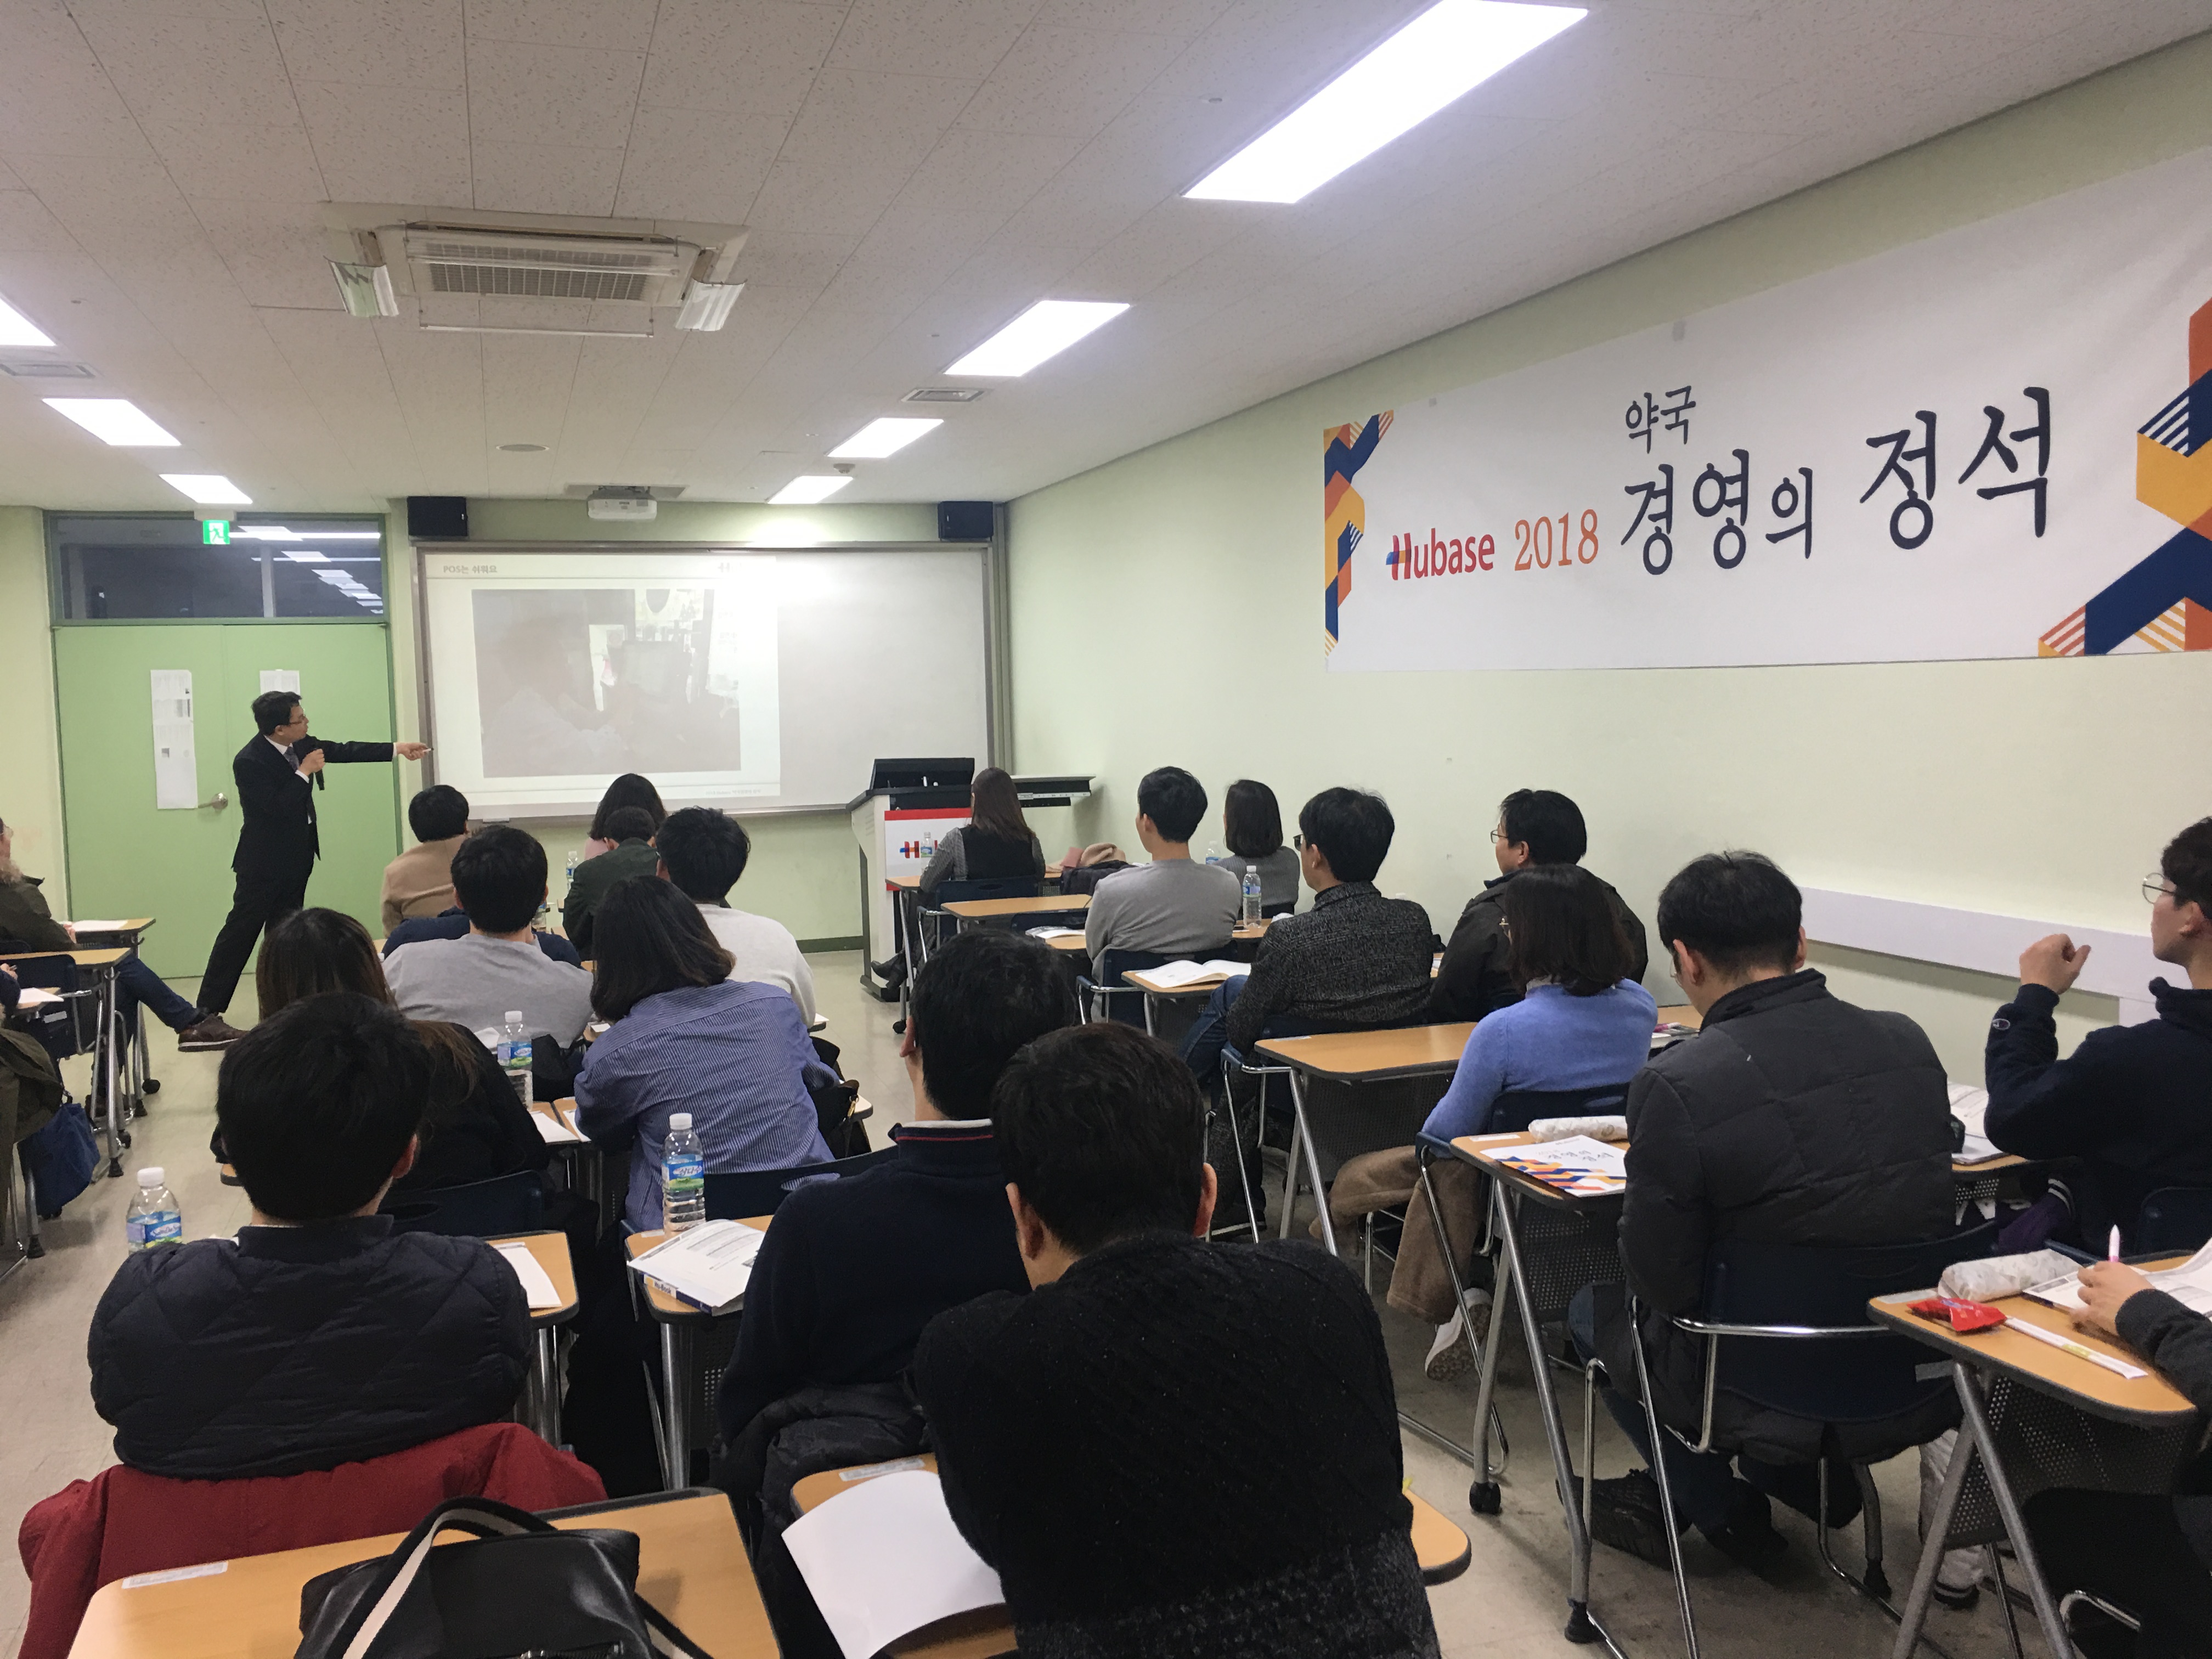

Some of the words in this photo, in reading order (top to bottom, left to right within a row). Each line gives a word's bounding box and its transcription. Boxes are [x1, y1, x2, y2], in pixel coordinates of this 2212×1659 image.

[1625, 385, 1696, 454] 약국
[1620, 448, 1813, 575] 경영의
[1859, 386, 2051, 550] 정석
[443, 565, 469, 574] POS는
[1386, 527, 1495, 581] Hubase
[1514, 509, 1599, 571] 2018
